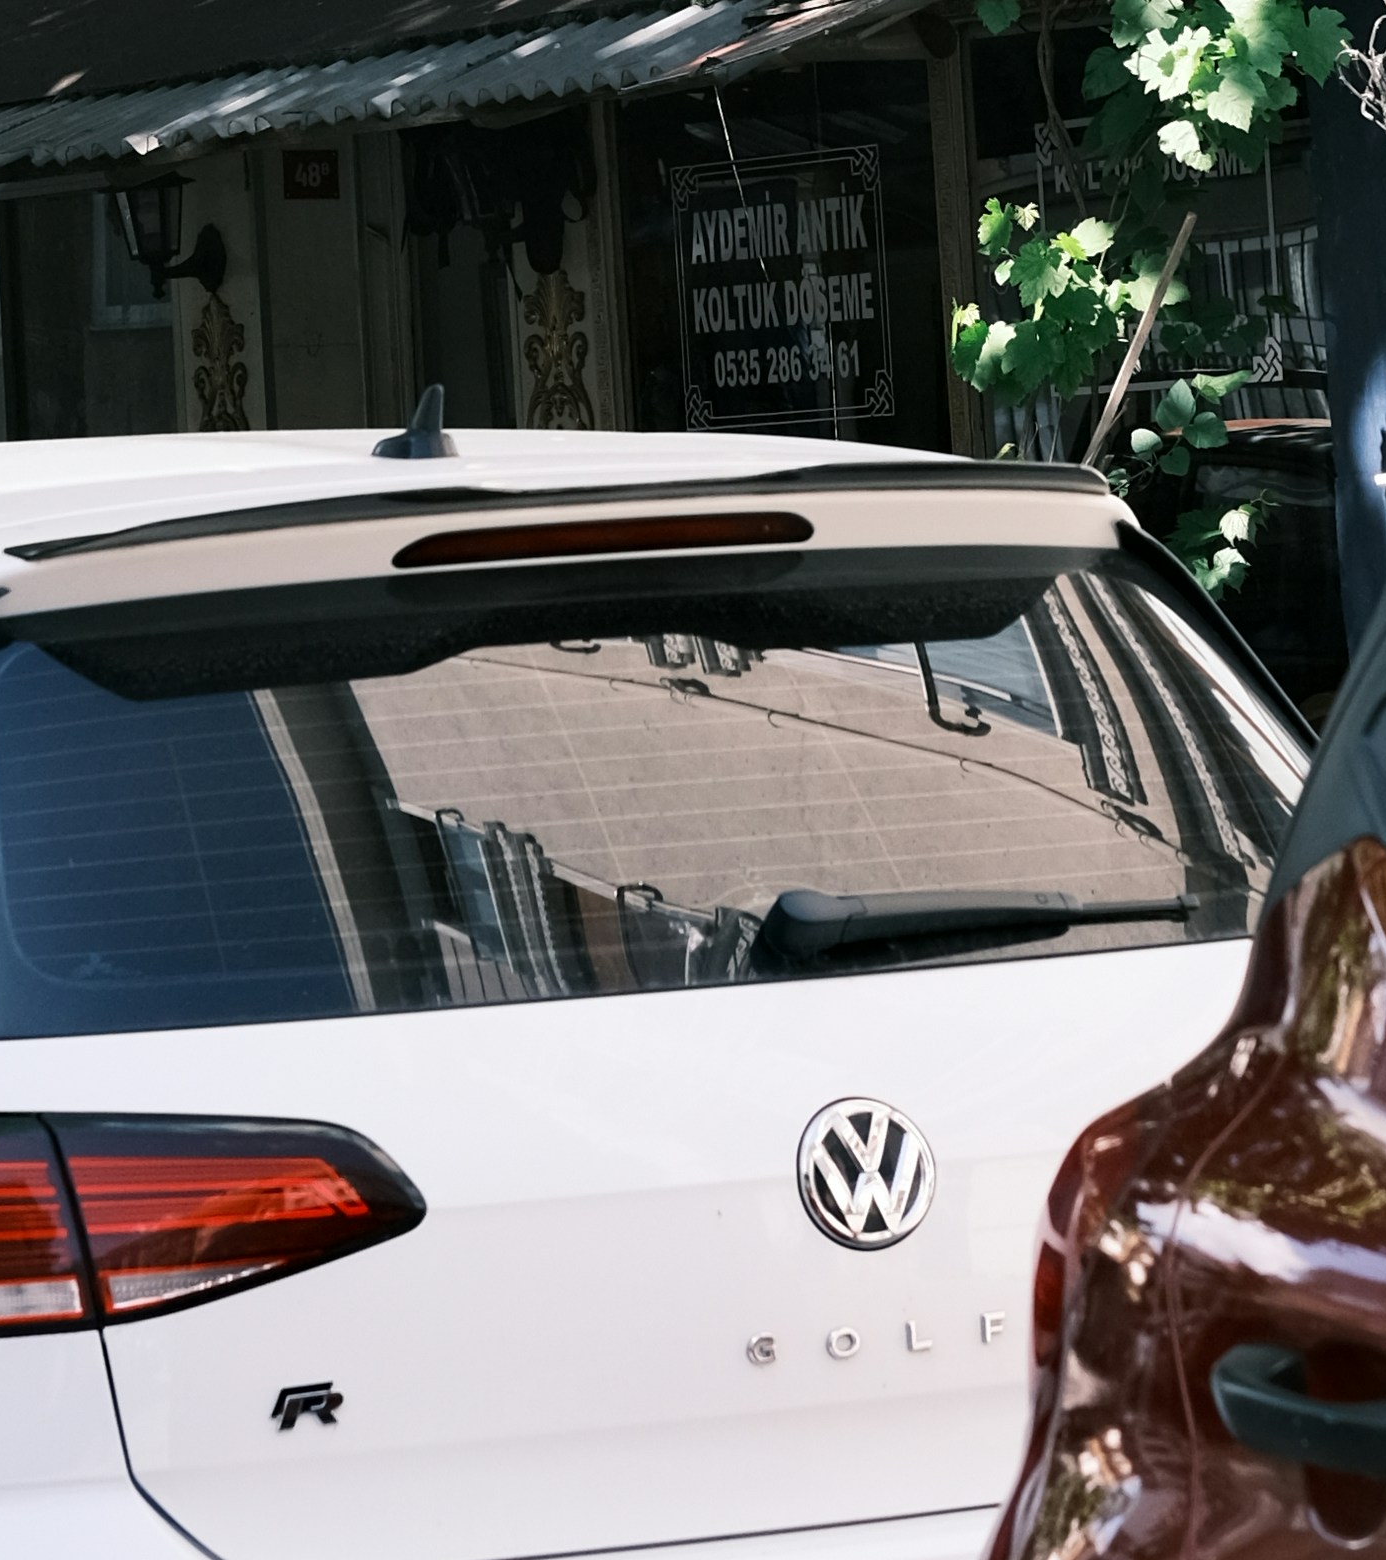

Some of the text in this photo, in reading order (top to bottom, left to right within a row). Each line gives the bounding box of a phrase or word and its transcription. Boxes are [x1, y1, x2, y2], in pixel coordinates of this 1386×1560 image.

[691, 181, 868, 265] AYDEMİR ANTİK
[693, 281, 780, 334] KOLTUK
[714, 347, 761, 388] 0535
[766, 344, 802, 383] 286
[837, 339, 861, 379] 61
